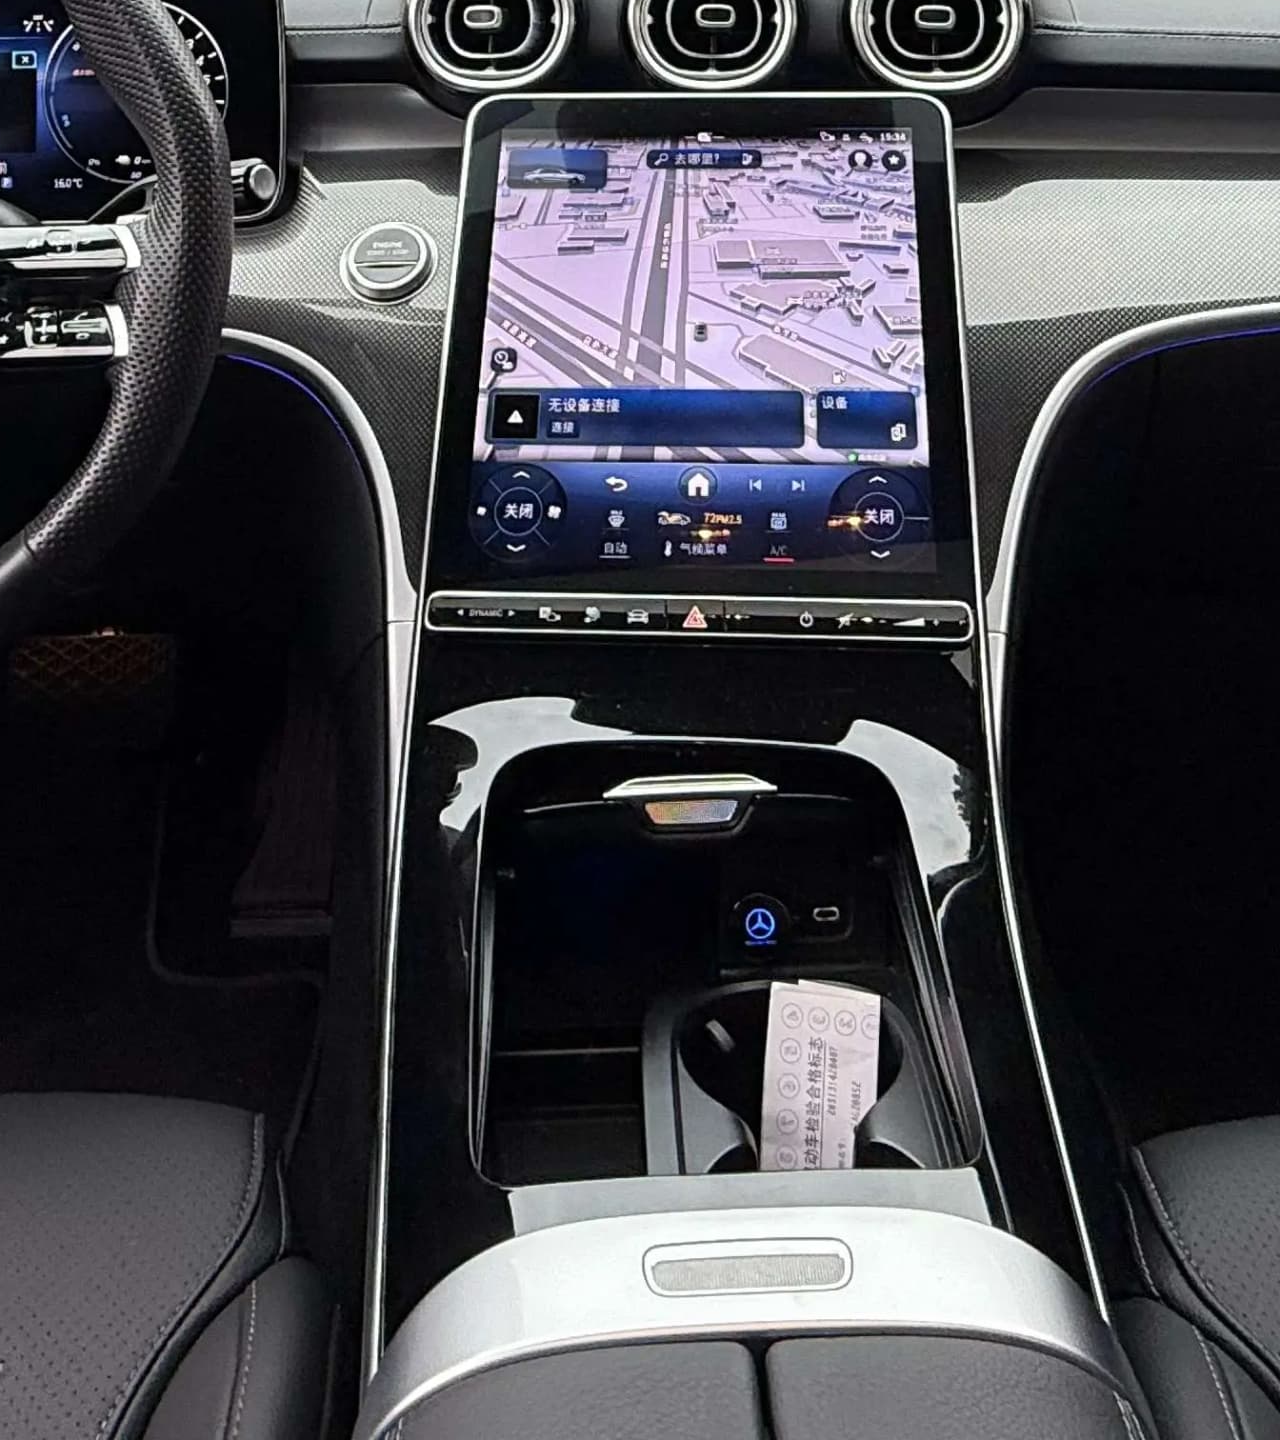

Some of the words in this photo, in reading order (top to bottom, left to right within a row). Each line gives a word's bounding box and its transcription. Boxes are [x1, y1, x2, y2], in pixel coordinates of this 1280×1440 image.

[548, 397, 620, 413] 无设备连接
[821, 396, 848, 410] 设备
[551, 421, 574, 433] 连接
[503, 503, 533, 519] 关闭
[864, 508, 894, 525] 关闭
[604, 542, 628, 554] 自动
[770, 545, 787, 556] A/C
[469, 609, 503, 618] DYNAMIC
